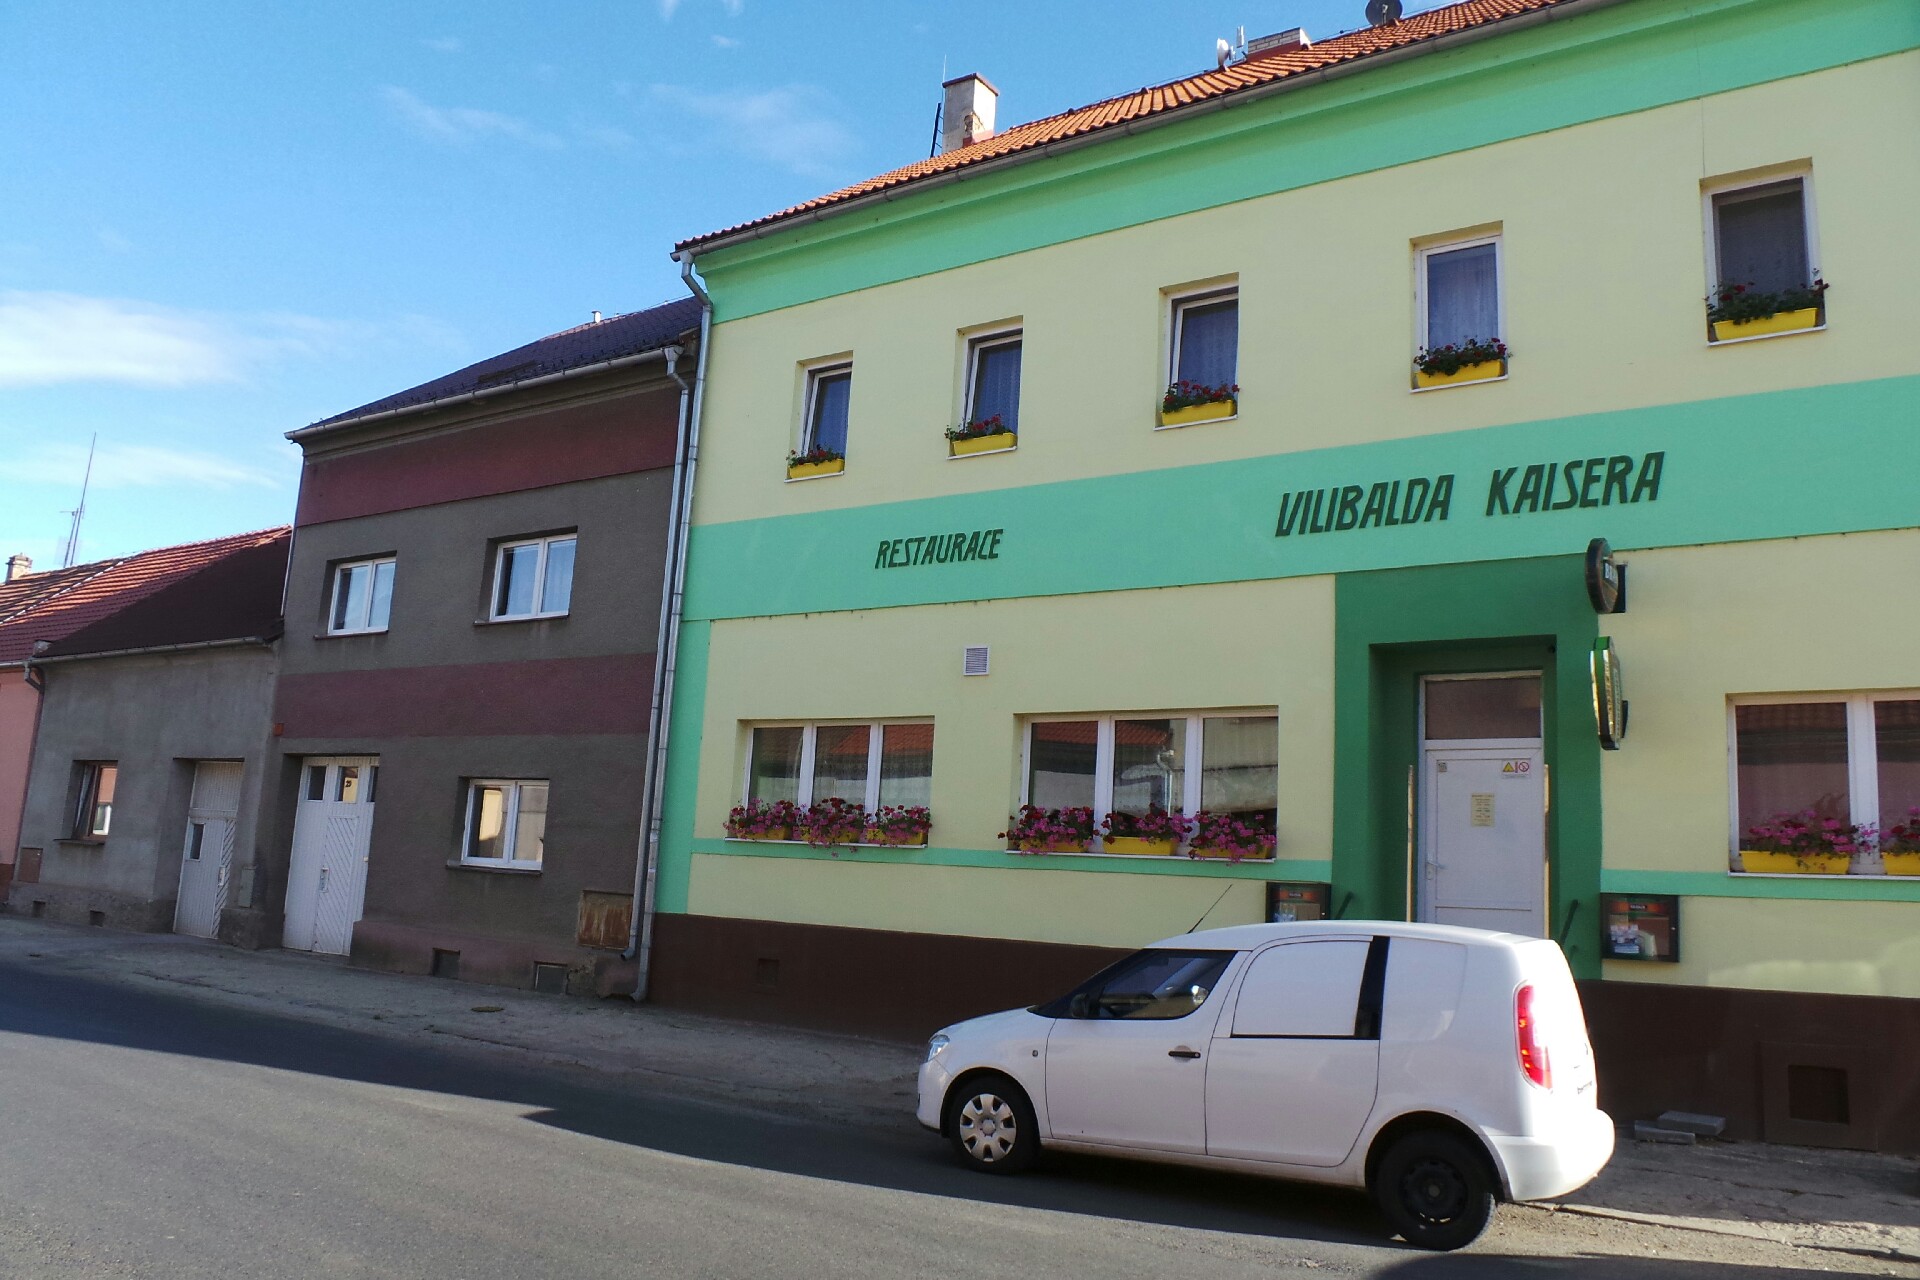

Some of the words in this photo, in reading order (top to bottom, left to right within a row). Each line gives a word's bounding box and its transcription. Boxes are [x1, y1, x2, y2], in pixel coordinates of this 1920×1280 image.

[1275, 474, 1455, 537] VILIBALDA
[1486, 451, 1665, 517] KAISERA
[874, 528, 1004, 569] RESTAURACE
